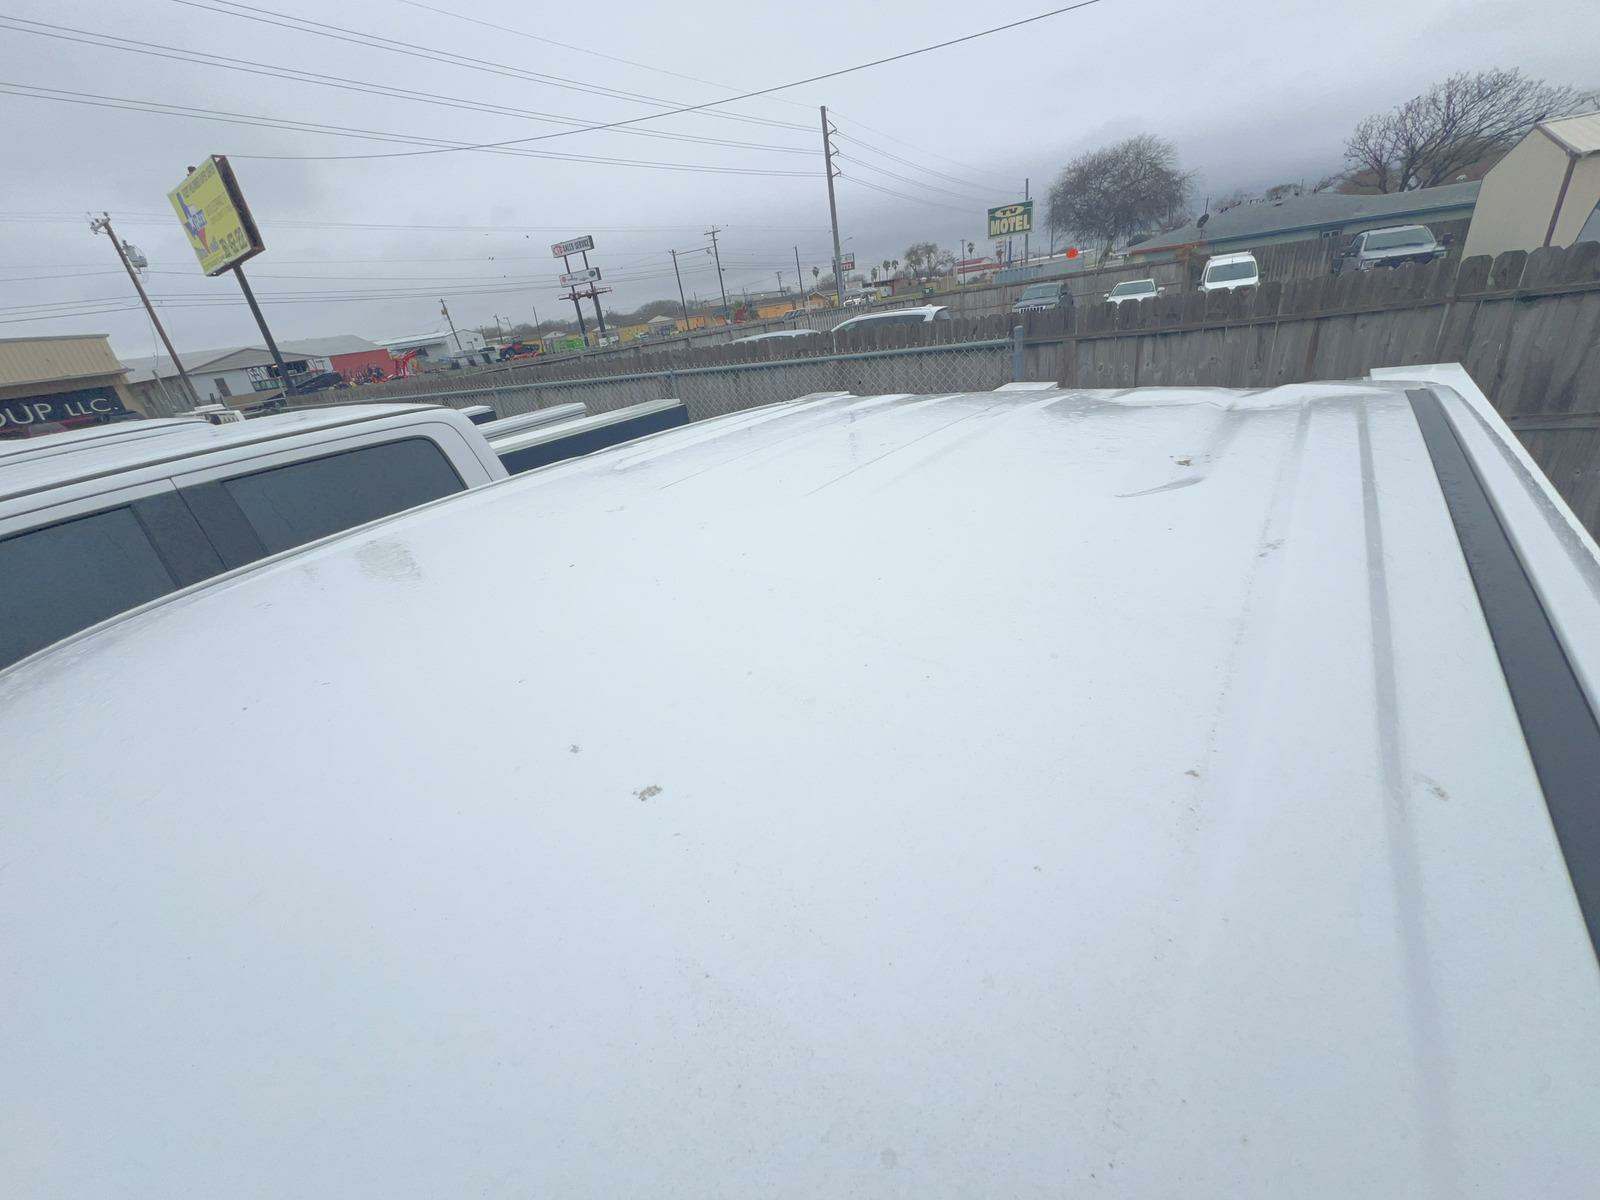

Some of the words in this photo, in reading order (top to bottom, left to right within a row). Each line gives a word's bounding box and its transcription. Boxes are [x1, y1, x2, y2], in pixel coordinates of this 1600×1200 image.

[990, 214, 1031, 236] MOTEL
[0, 403, 52, 428] UP
[64, 398, 119, 417] LLC.
